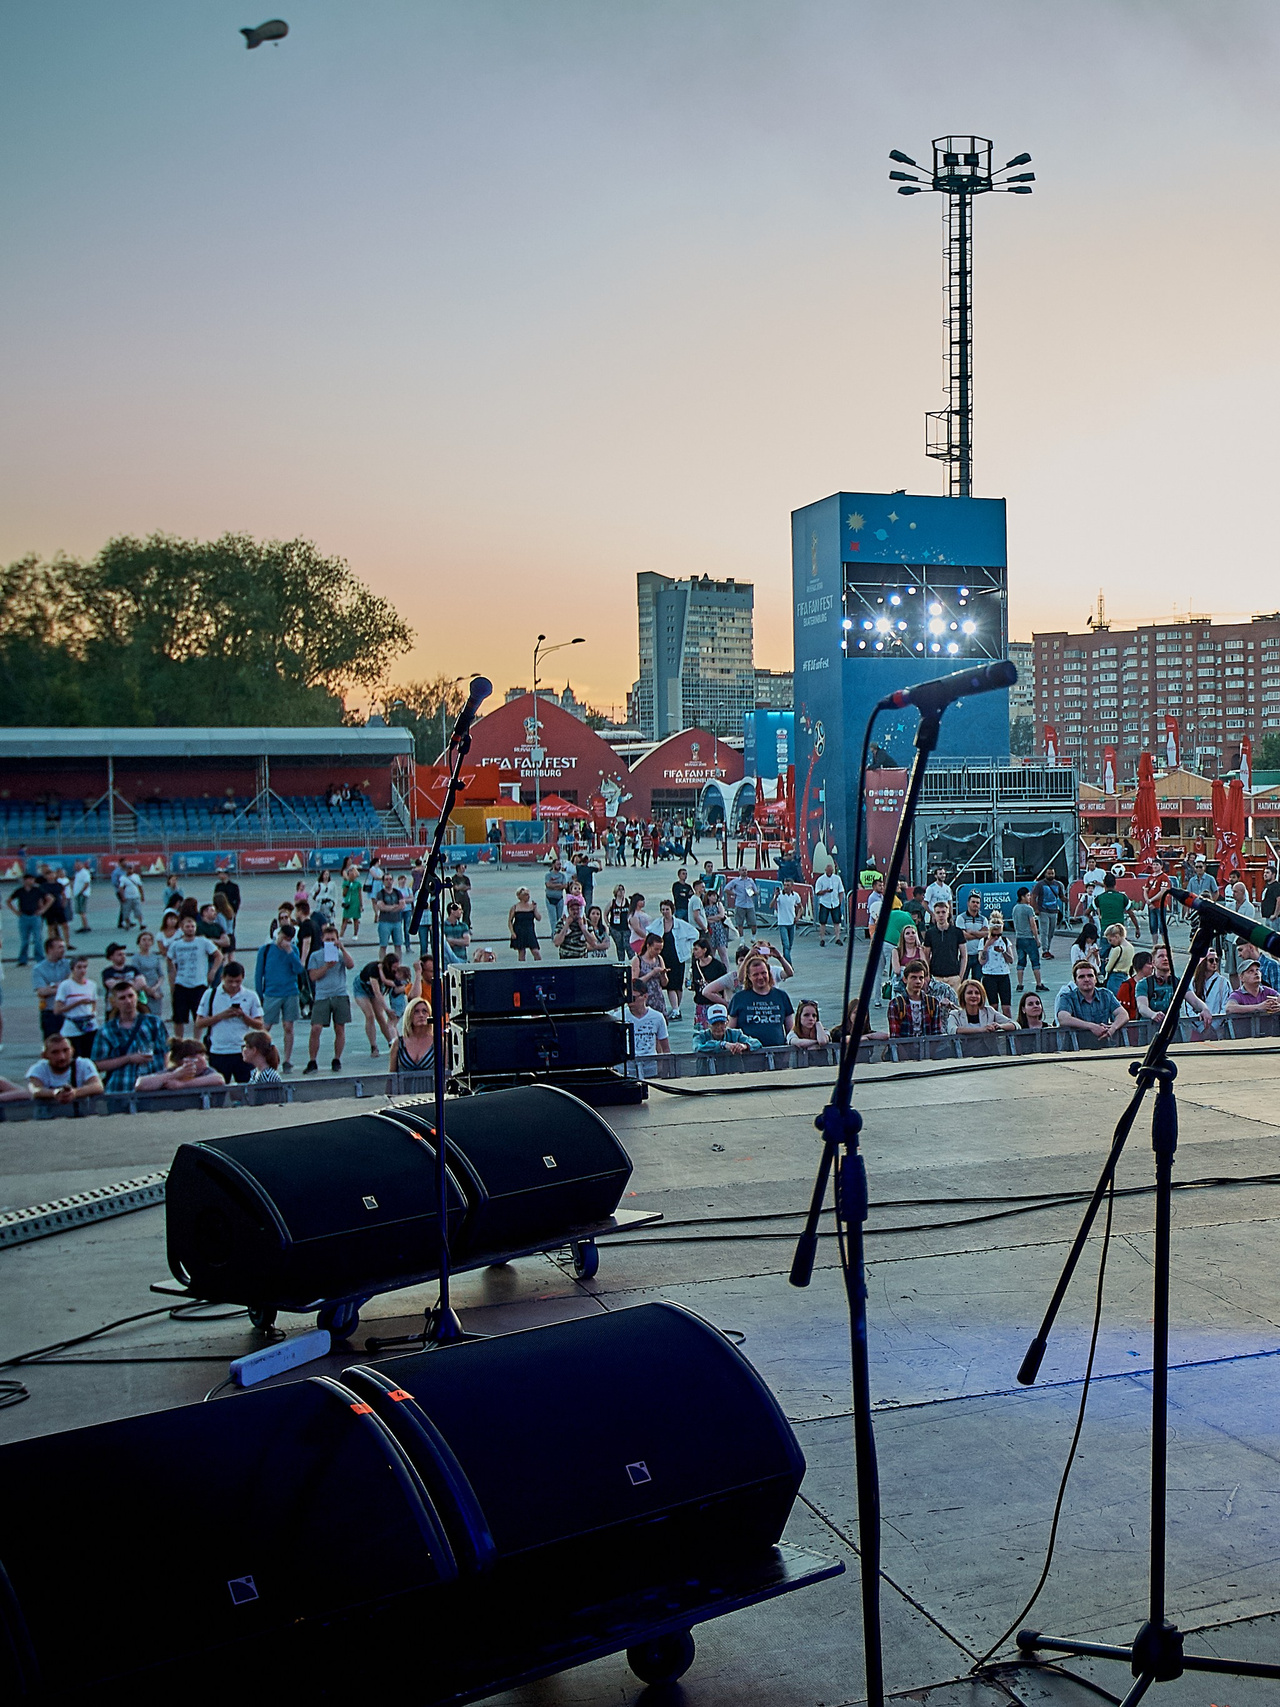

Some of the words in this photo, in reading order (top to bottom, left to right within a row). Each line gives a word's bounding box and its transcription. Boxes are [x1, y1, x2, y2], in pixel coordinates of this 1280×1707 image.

[820, 595, 833, 611] FEST
[514, 758, 542, 768] FAN
[545, 758, 578, 768] FEST
[520, 769, 561, 777] ERINBURG
[664, 770, 683, 778] FIFA
[685, 770, 703, 778] FAN
[705, 770, 726, 778] FET
[746, 1015, 781, 1023] FORCE
